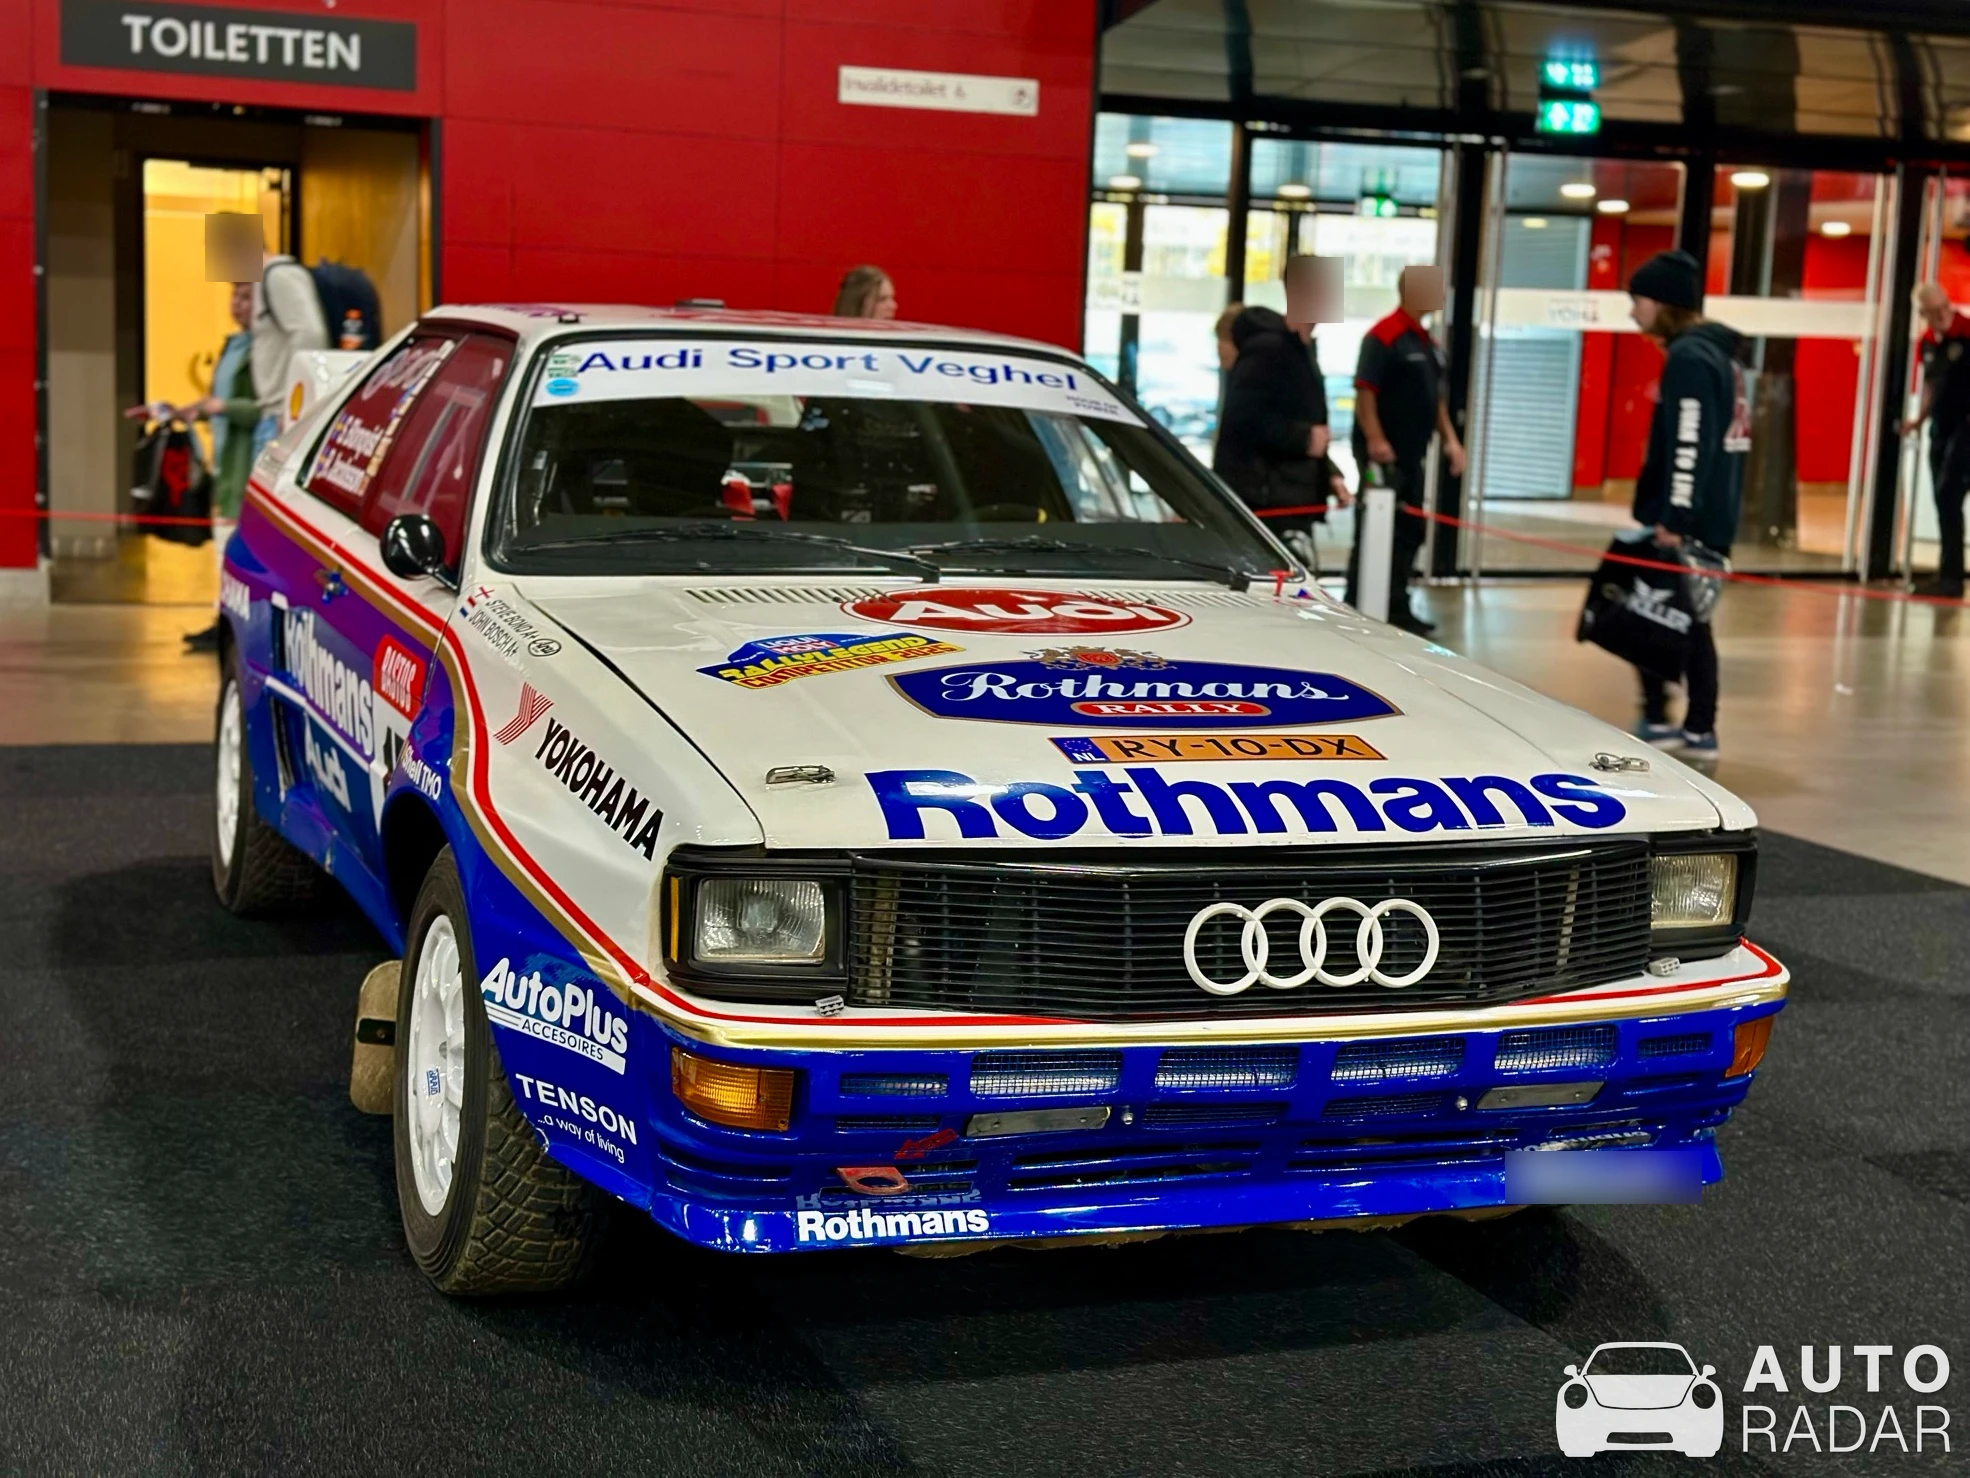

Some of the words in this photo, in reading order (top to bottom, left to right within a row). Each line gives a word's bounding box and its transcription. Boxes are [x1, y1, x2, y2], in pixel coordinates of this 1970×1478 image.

[121, 14, 361, 71] TOILETTEN
[577, 349, 703, 373] Audi
[727, 348, 879, 374] Sport
[897, 354, 1079, 390] Veghel
[468, 609, 491, 632] JOHN
[484, 622, 515, 651] BOSCH
[485, 599, 516, 619] STEVE
[503, 613, 534, 633] BOND
[718, 637, 928, 679] RALLYLEGEND
[759, 636, 821, 648] LIQUI
[771, 641, 838, 655] MOLY
[284, 608, 374, 757] Rothmans
[741, 655, 889, 687] COMPETITOR
[892, 643, 957, 660] 2025
[941, 670, 1348, 702] Rothmans
[1099, 703, 1241, 714] RALLY
[1073, 752, 1105, 761] NL
[1113, 738, 1365, 758] RY-10-DX
[402, 744, 421, 784] Shell
[420, 764, 442, 800] TMO
[535, 717, 664, 861] YOKOHAMA
[865, 767, 1626, 840] Rothmans
[481, 958, 628, 1054] AutoPlus
[522, 1019, 604, 1060] ACCESOIRES
[515, 1073, 637, 1145] TENSON
[555, 1118, 582, 1140] way
[584, 1127, 595, 1144] of
[596, 1131, 625, 1164] living
[797, 1208, 990, 1243] Rothmans
